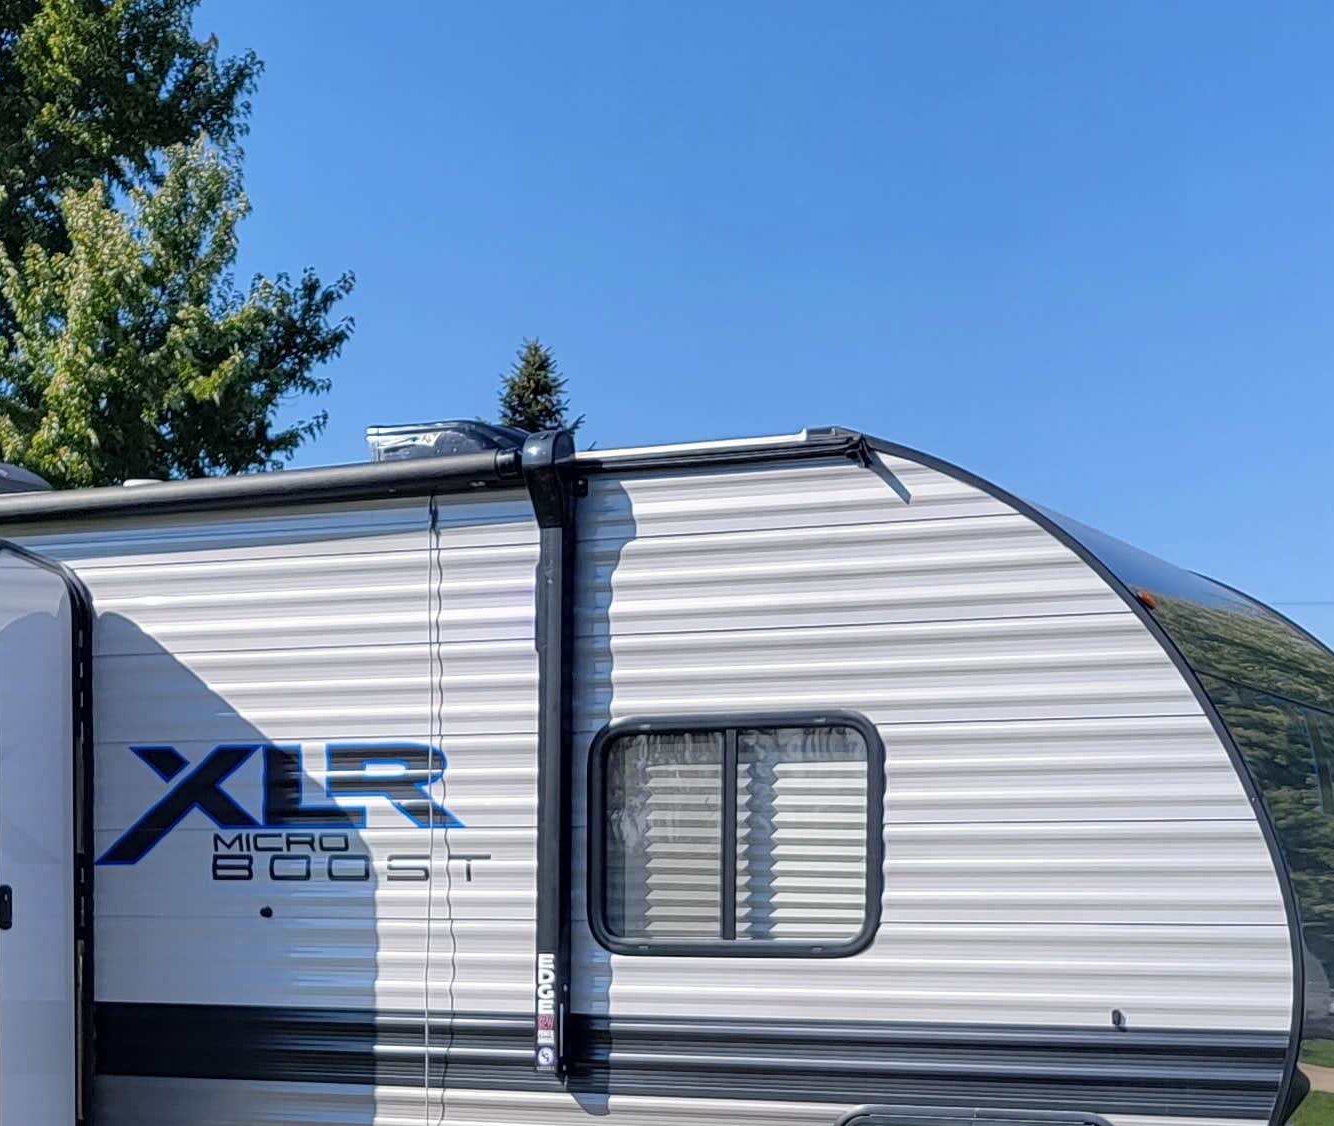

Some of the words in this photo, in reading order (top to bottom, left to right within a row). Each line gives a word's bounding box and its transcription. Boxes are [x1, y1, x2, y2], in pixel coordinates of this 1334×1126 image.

[94, 741, 466, 866] XLR
[212, 832, 349, 853] MICRO
[212, 854, 492, 882] BOOST
[537, 953, 555, 1015] EDGE
